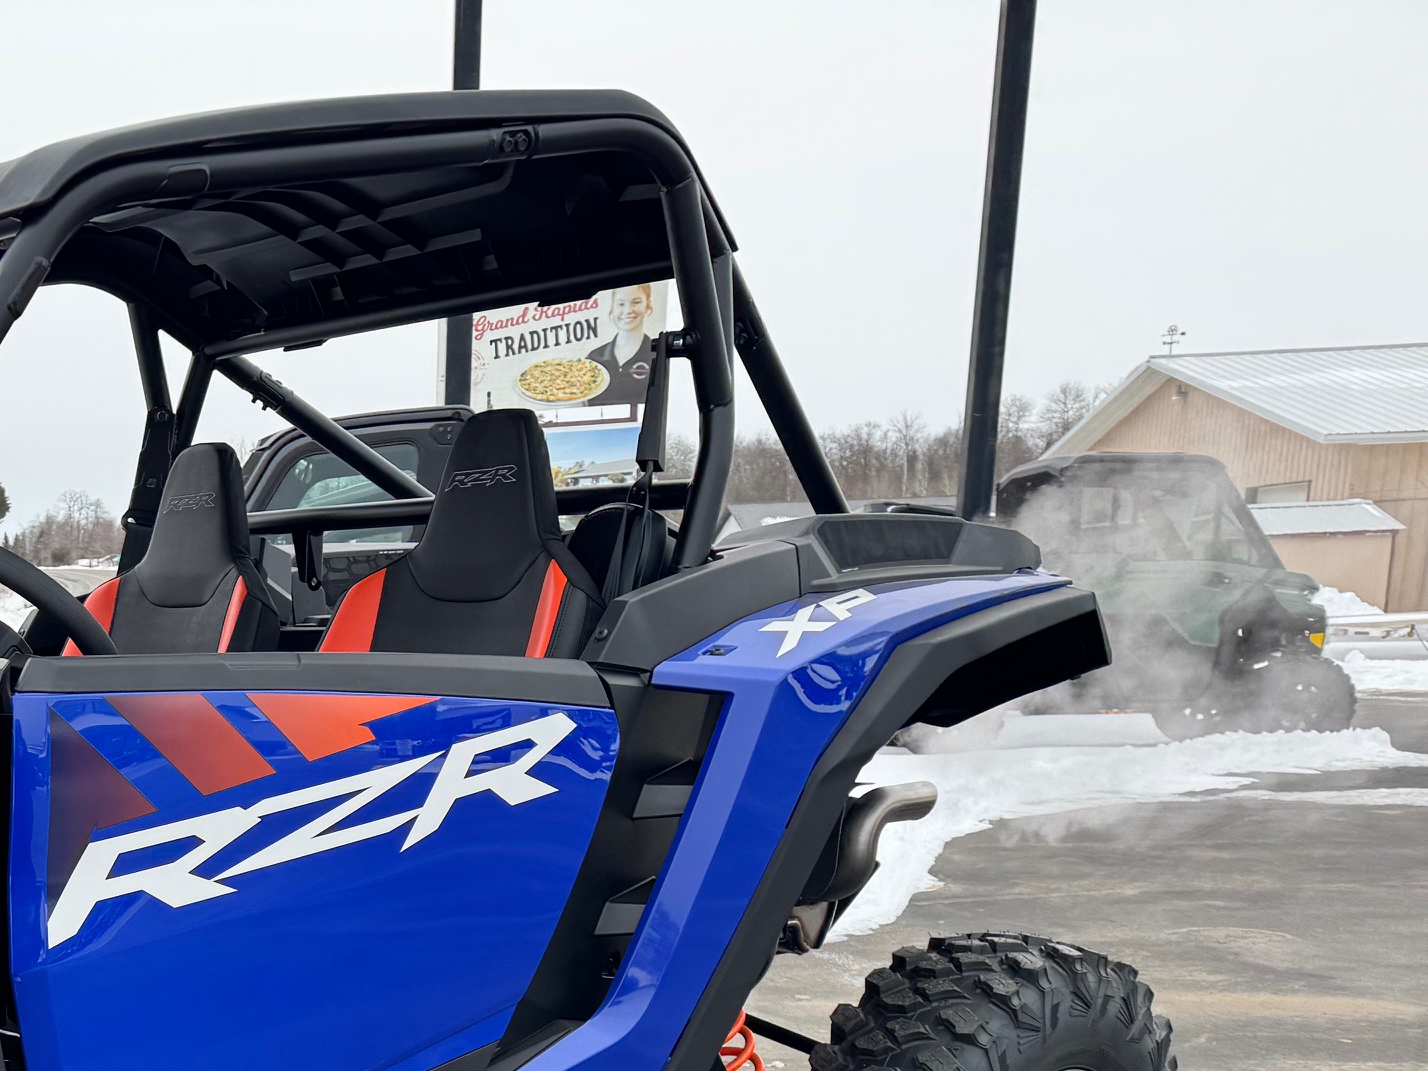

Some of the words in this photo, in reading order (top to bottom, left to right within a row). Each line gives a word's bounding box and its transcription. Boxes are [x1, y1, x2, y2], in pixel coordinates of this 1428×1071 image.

[473, 306, 529, 340] Grand
[490, 317, 599, 359] TRADITION
[445, 465, 517, 491] RZR
[163, 492, 215, 514] RZR
[758, 588, 878, 659] XP
[47, 712, 577, 949] RZR
